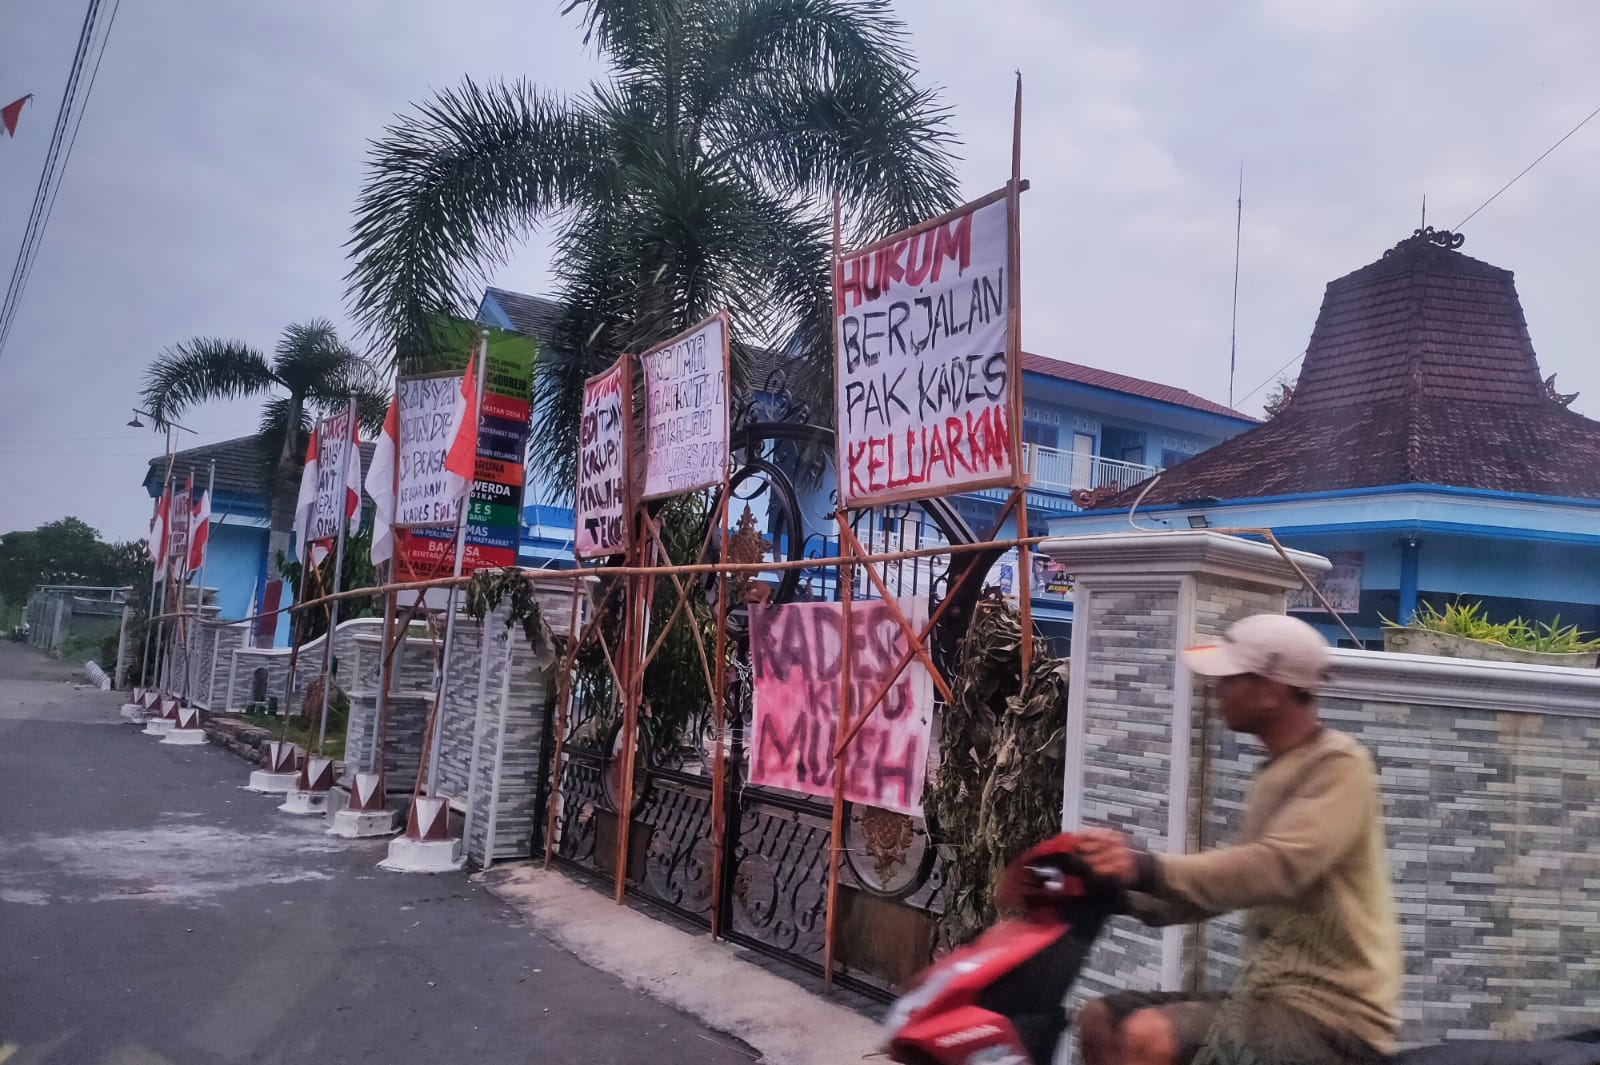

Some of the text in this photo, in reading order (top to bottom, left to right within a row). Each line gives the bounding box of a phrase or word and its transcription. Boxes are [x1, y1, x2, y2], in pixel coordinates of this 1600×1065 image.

[837, 212, 972, 315] HUKUM
[842, 267, 1004, 374] BERJALAN
[400, 377, 463, 411] RAKYA
[845, 352, 1006, 434] PAK KADES
[475, 460, 504, 474] ARUNA
[758, 712, 918, 808] MUEH
